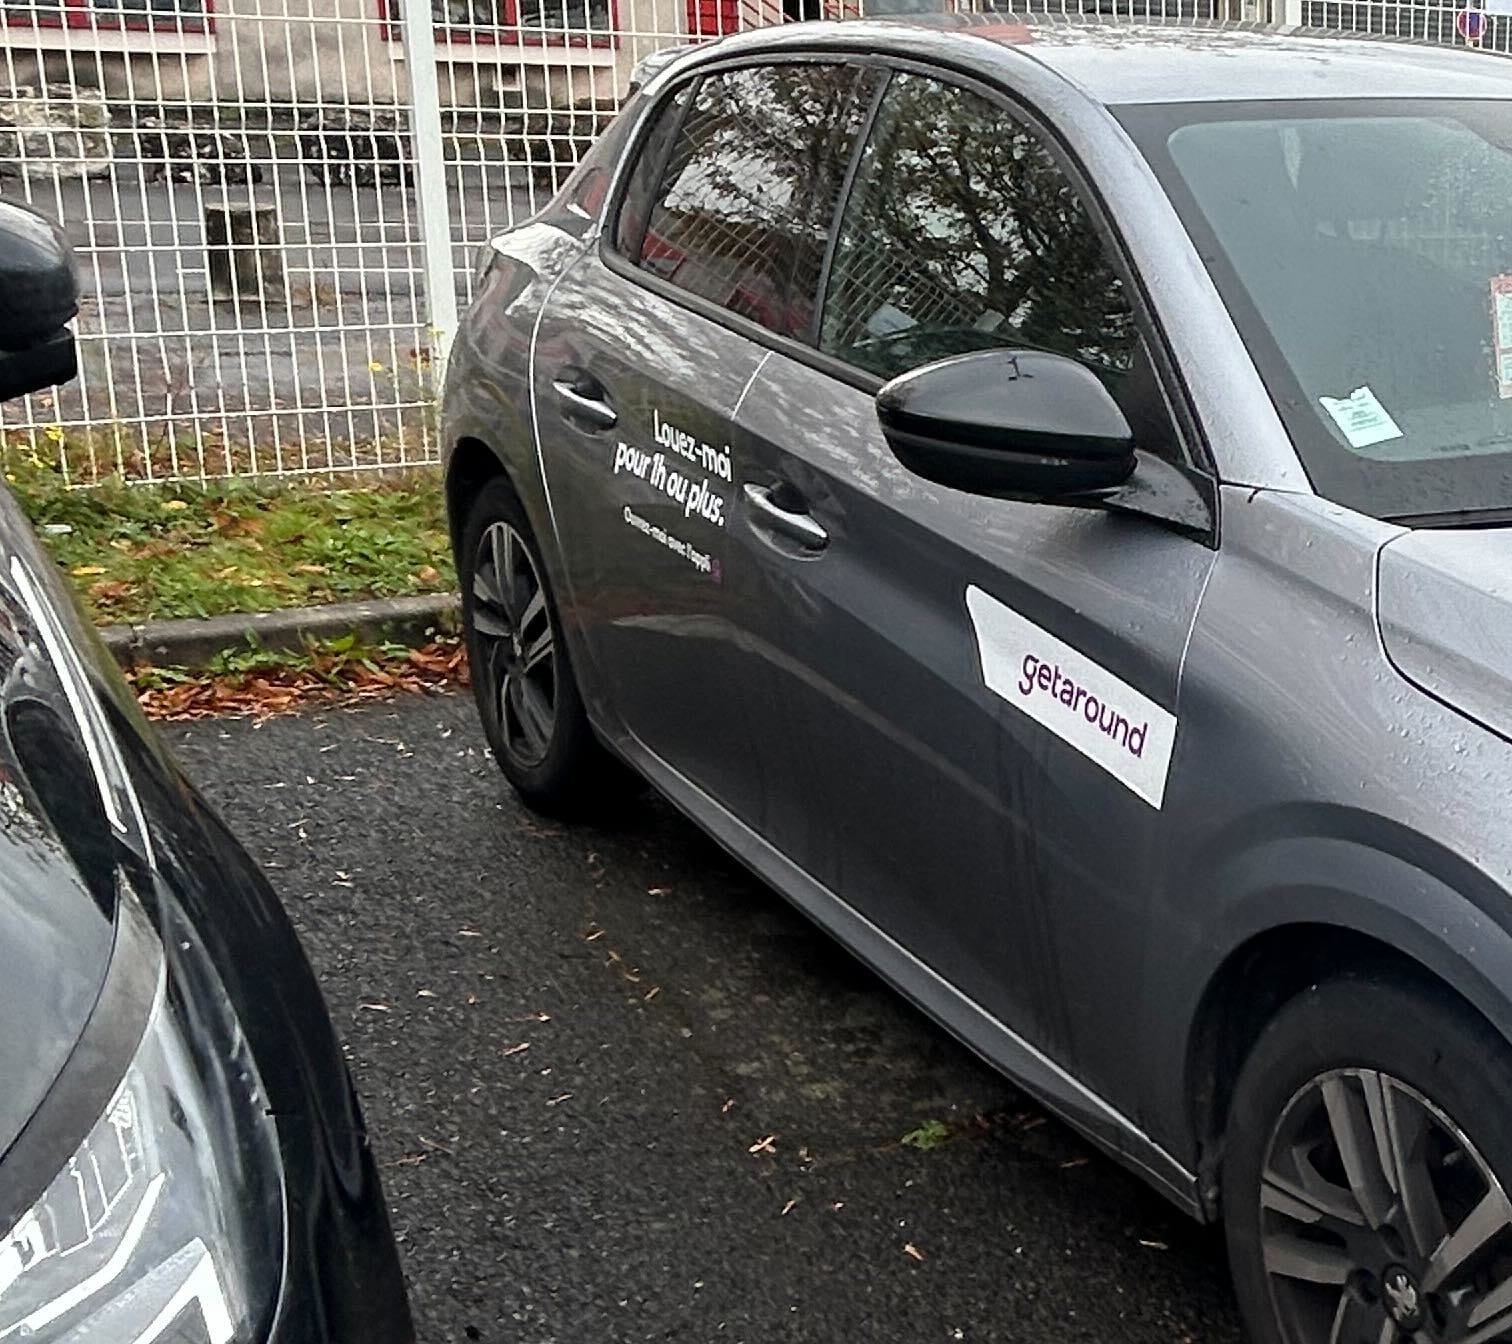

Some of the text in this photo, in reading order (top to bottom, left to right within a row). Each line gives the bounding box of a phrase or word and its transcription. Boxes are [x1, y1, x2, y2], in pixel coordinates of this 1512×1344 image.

[614, 442, 725, 526] pour 1h ou plus.
[653, 408, 733, 483] Louez-moi
[1018, 654, 1148, 758] getaround
